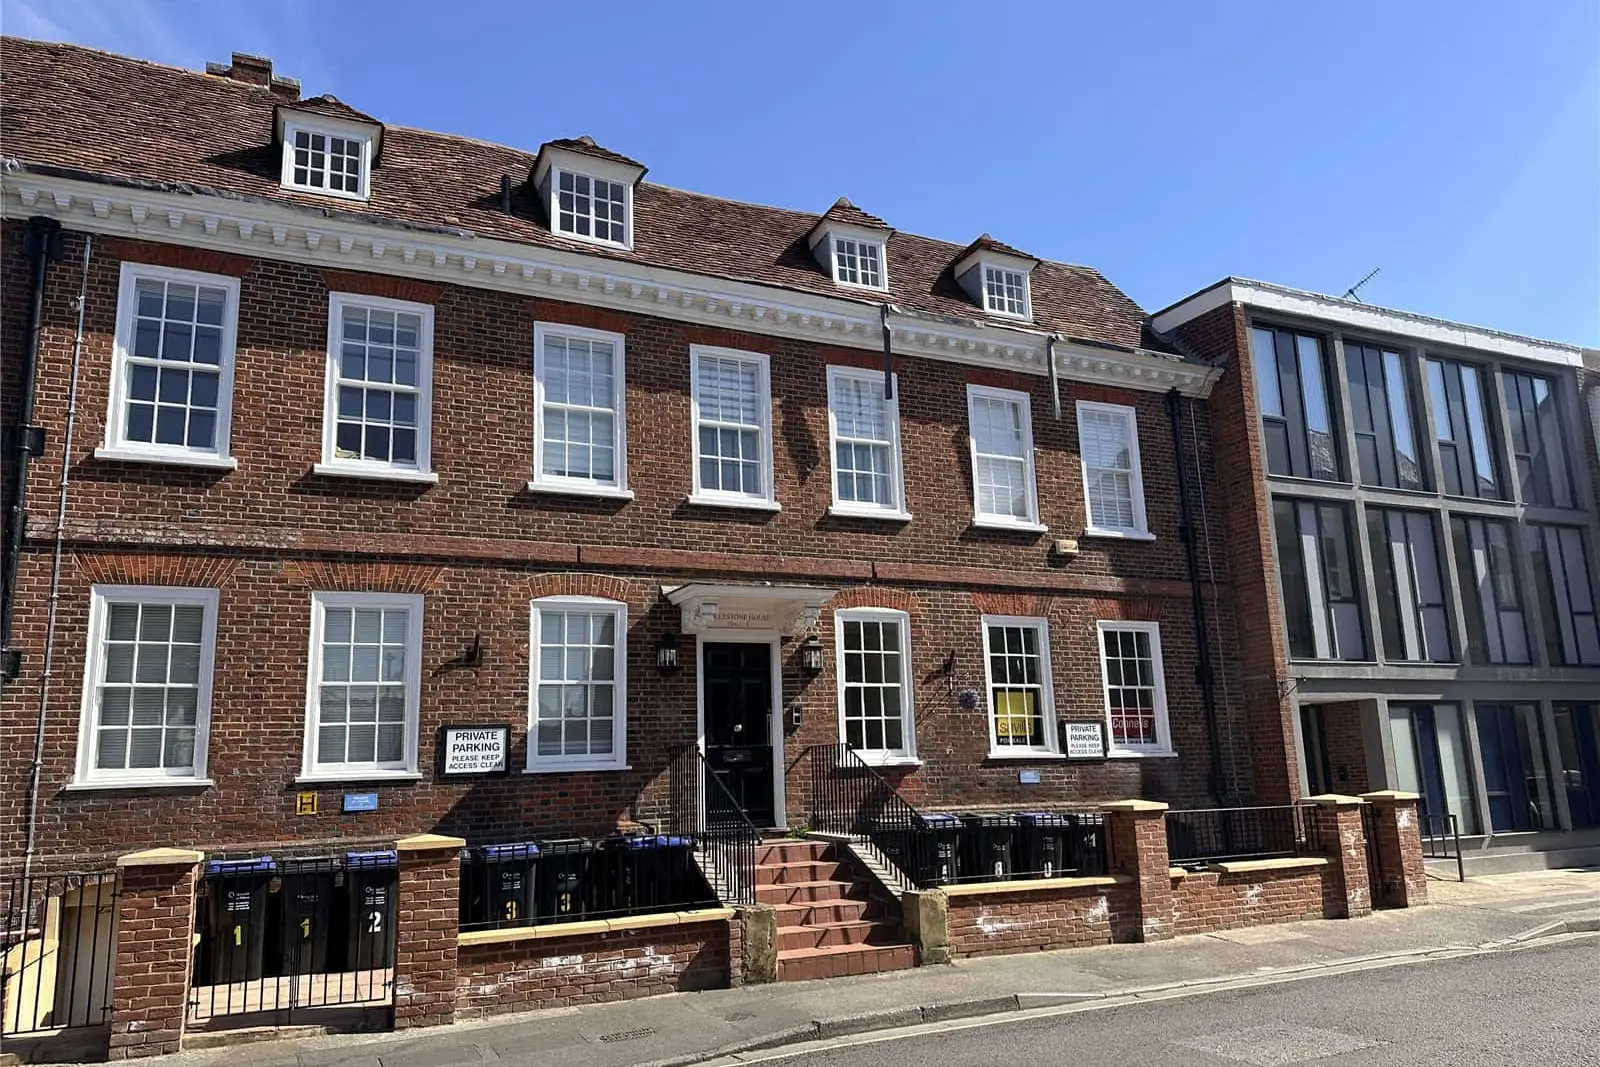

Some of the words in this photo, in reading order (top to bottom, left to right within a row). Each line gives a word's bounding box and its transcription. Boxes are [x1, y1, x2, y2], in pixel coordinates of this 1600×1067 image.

[455, 731, 498, 741] PRIVATE
[1070, 725, 1097, 733] PRIVATE
[1070, 734, 1100, 742] PARKING
[452, 742, 500, 752] PARKING
[300, 794, 315, 812] H
[505, 900, 517, 920] 3
[560, 892, 571, 912] 3
[367, 911, 382, 933] 2
[233, 924, 242, 946] 1
